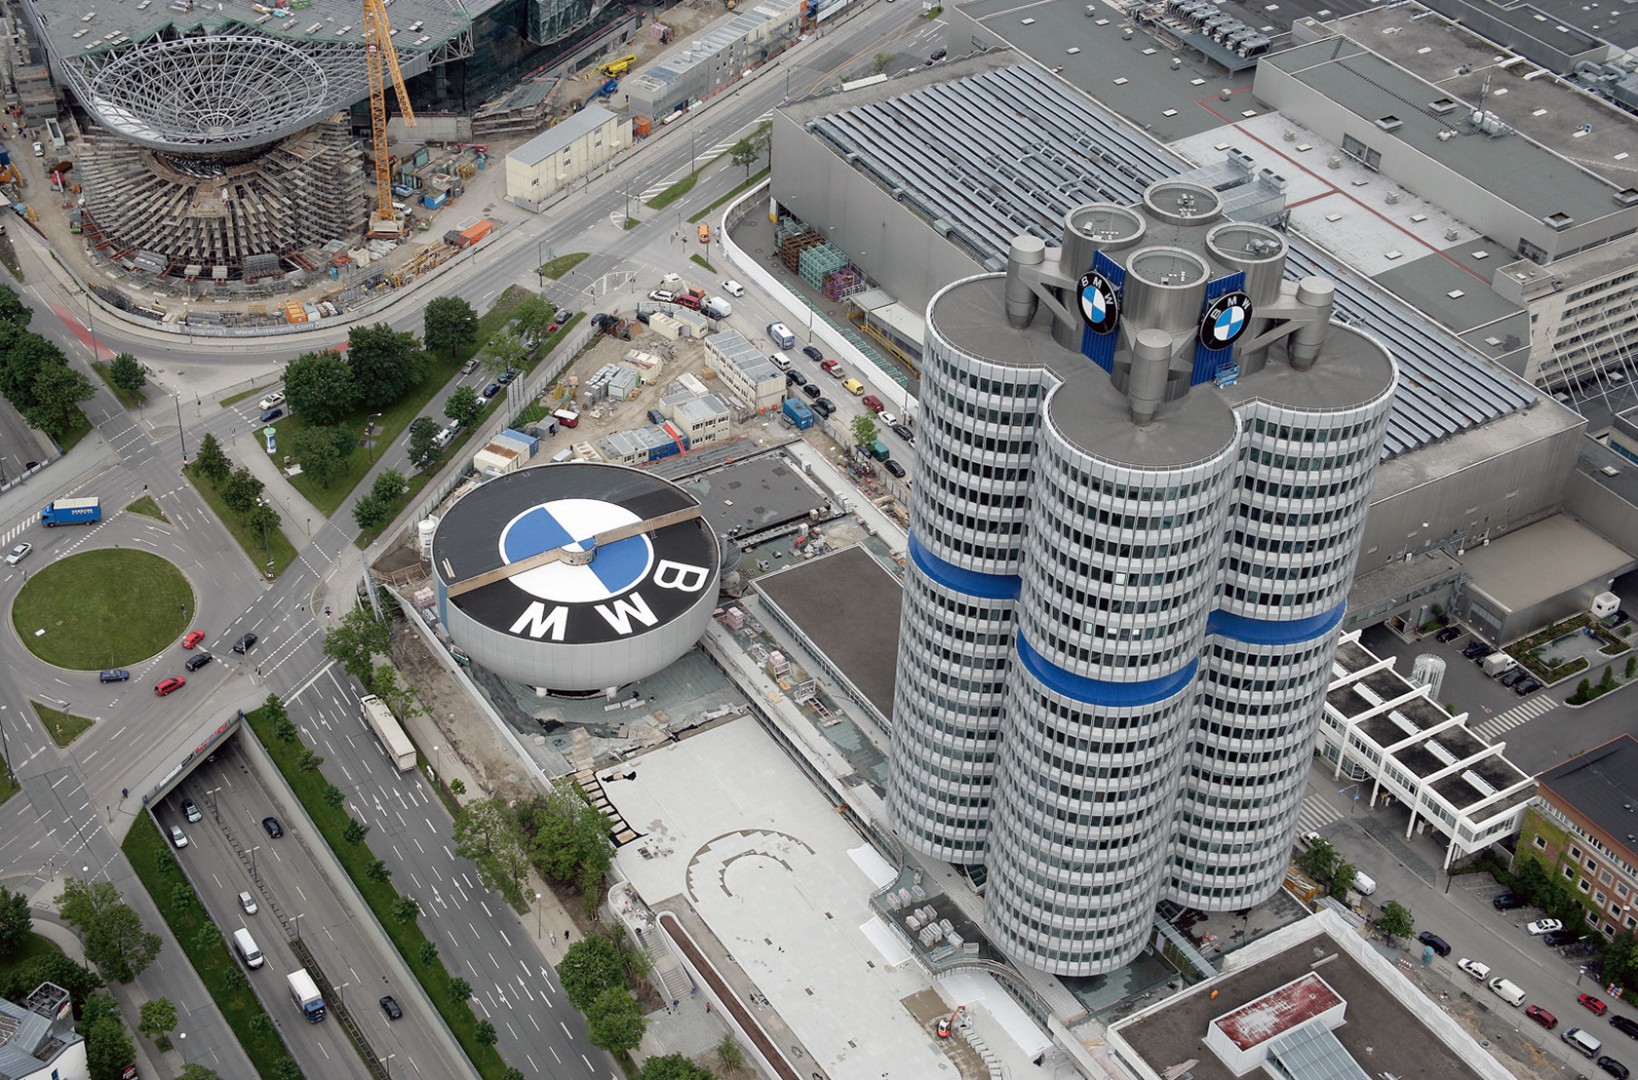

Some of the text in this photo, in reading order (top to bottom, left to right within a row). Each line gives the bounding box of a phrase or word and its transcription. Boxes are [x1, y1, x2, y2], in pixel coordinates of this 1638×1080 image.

[1081, 277, 1114, 305] BMW
[1210, 297, 1252, 320] BMW
[509, 559, 709, 641] BMW
